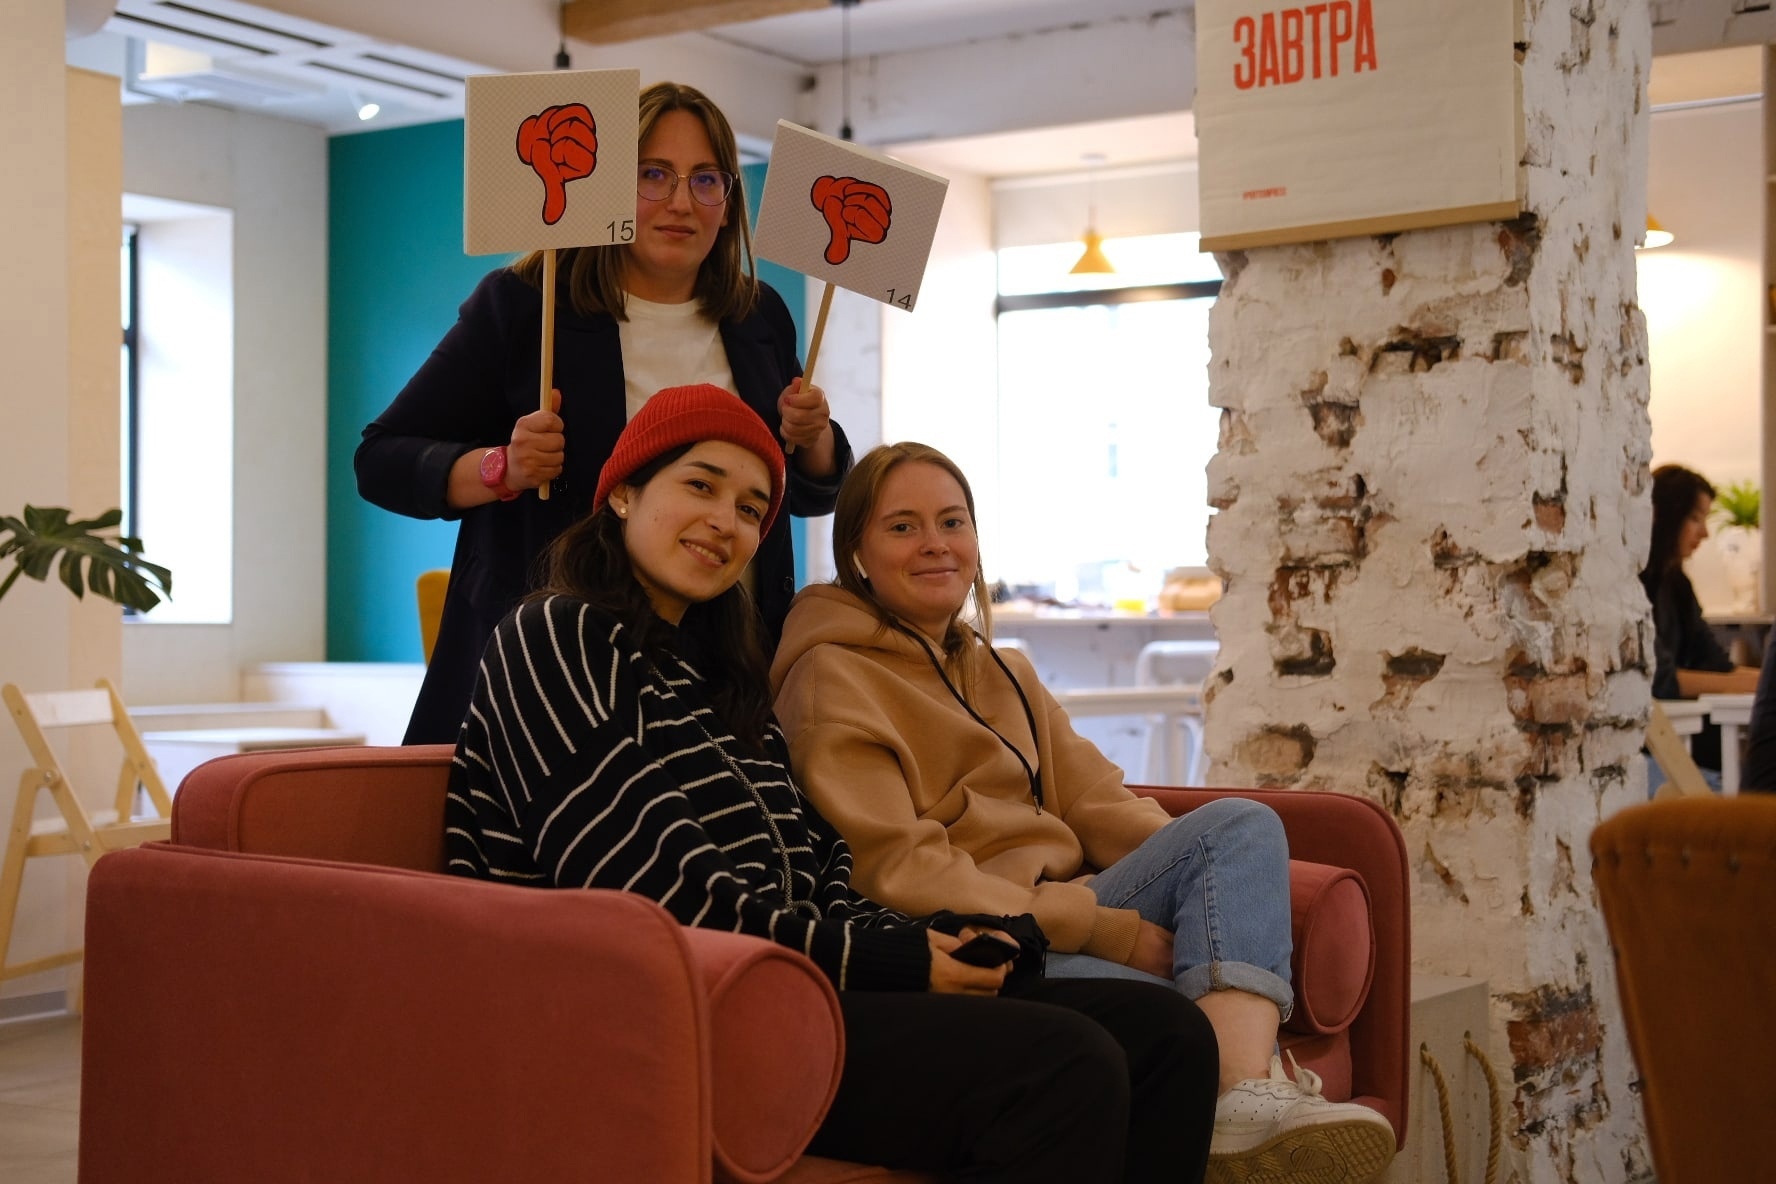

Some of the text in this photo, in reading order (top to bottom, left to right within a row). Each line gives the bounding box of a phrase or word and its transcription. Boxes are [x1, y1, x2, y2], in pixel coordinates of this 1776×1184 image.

[1234, 0, 1377, 90] ЗАВТРА
[607, 220, 634, 242] 15
[887, 289, 911, 309] 14
